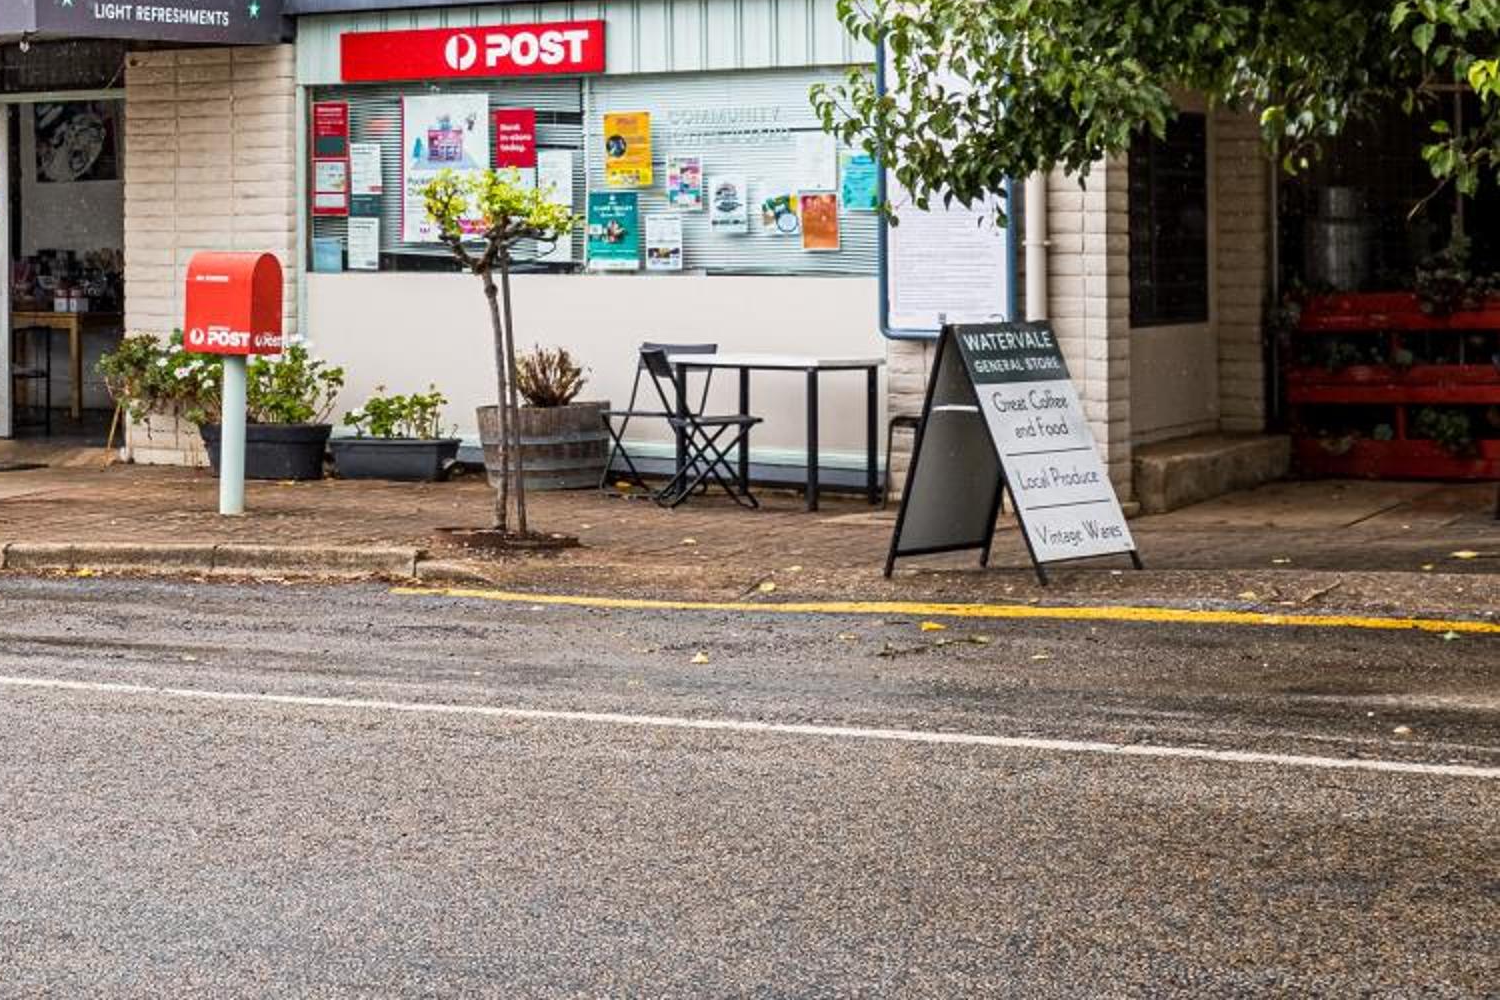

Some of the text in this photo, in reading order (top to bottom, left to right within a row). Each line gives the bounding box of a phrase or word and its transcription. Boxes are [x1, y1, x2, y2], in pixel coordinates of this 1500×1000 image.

[94, 3, 229, 26] LIGHT REFRESHMENTS
[485, 29, 589, 67] POST
[207, 331, 250, 347] POST
[963, 331, 1053, 352] WATERVALE
[973, 357, 1060, 373] GENERAL STORE
[992, 390, 1068, 412] Great Coffee
[1015, 416, 1068, 438] and Food
[1015, 466, 1100, 490] Local Produce
[1036, 520, 1123, 546] Vintage Wares
